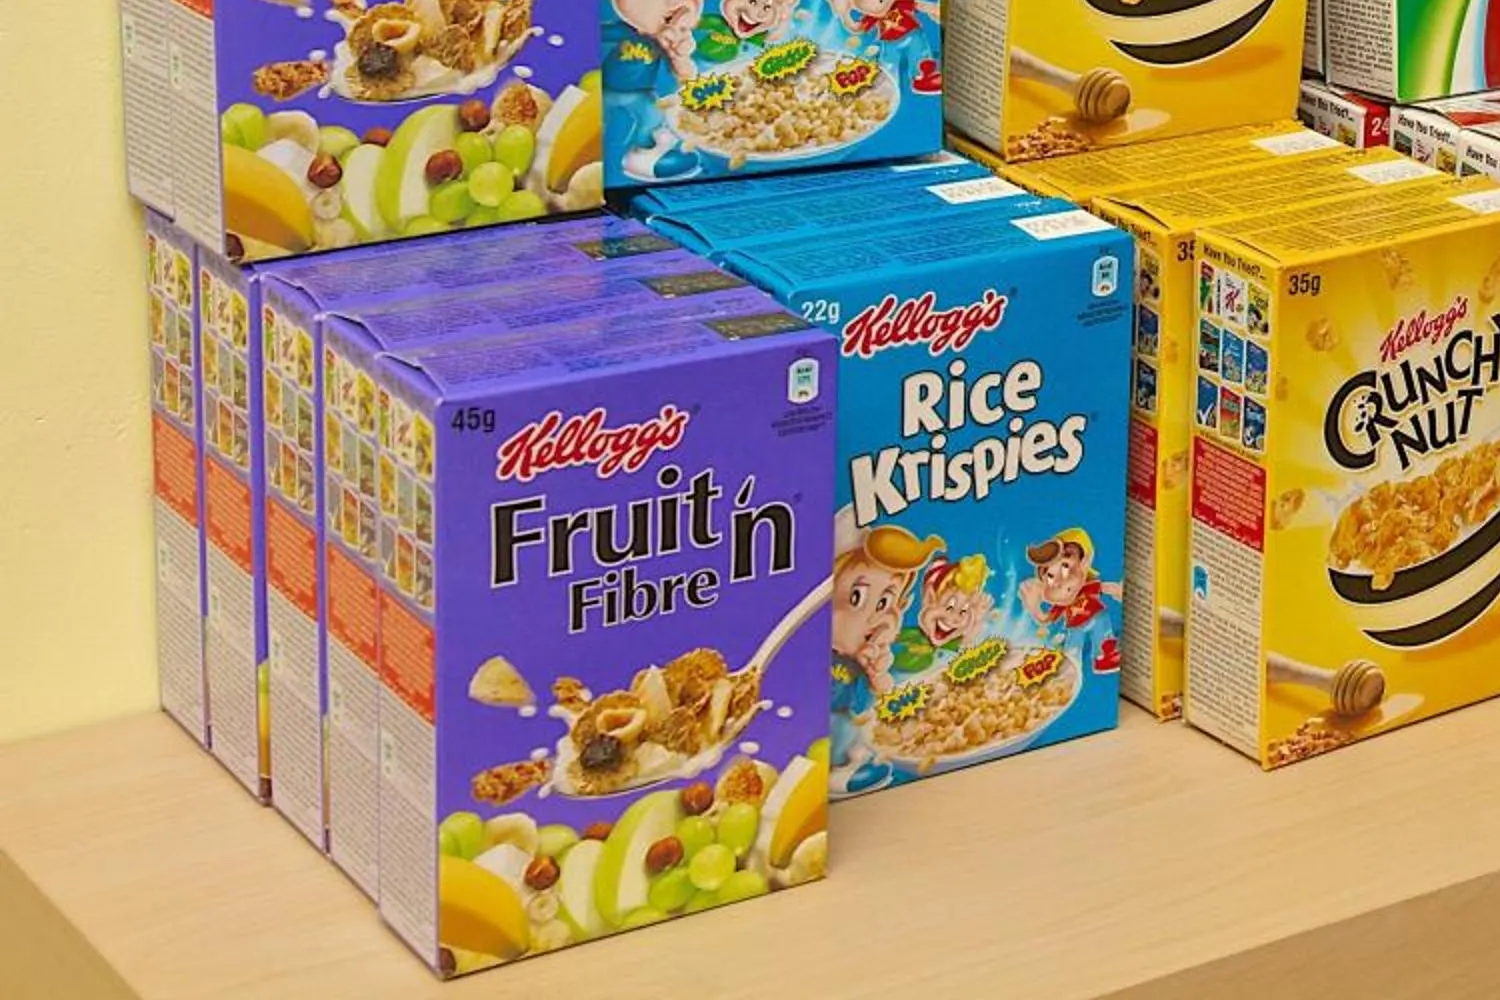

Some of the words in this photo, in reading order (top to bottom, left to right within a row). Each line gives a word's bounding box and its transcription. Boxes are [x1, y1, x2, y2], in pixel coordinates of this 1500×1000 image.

[801, 299, 841, 324] 22g
[1289, 271, 1321, 297] 35g
[842, 290, 1009, 359] Kellogg's
[1379, 296, 1470, 364] Kellogg's
[451, 406, 496, 433] 45g
[902, 358, 1044, 439] Rice
[1389, 387, 1484, 471] NUT
[496, 404, 690, 484] Kellogg's
[850, 414, 1088, 524] Krispies
[490, 464, 723, 589] Fruit
[568, 566, 720, 635] Fibre
